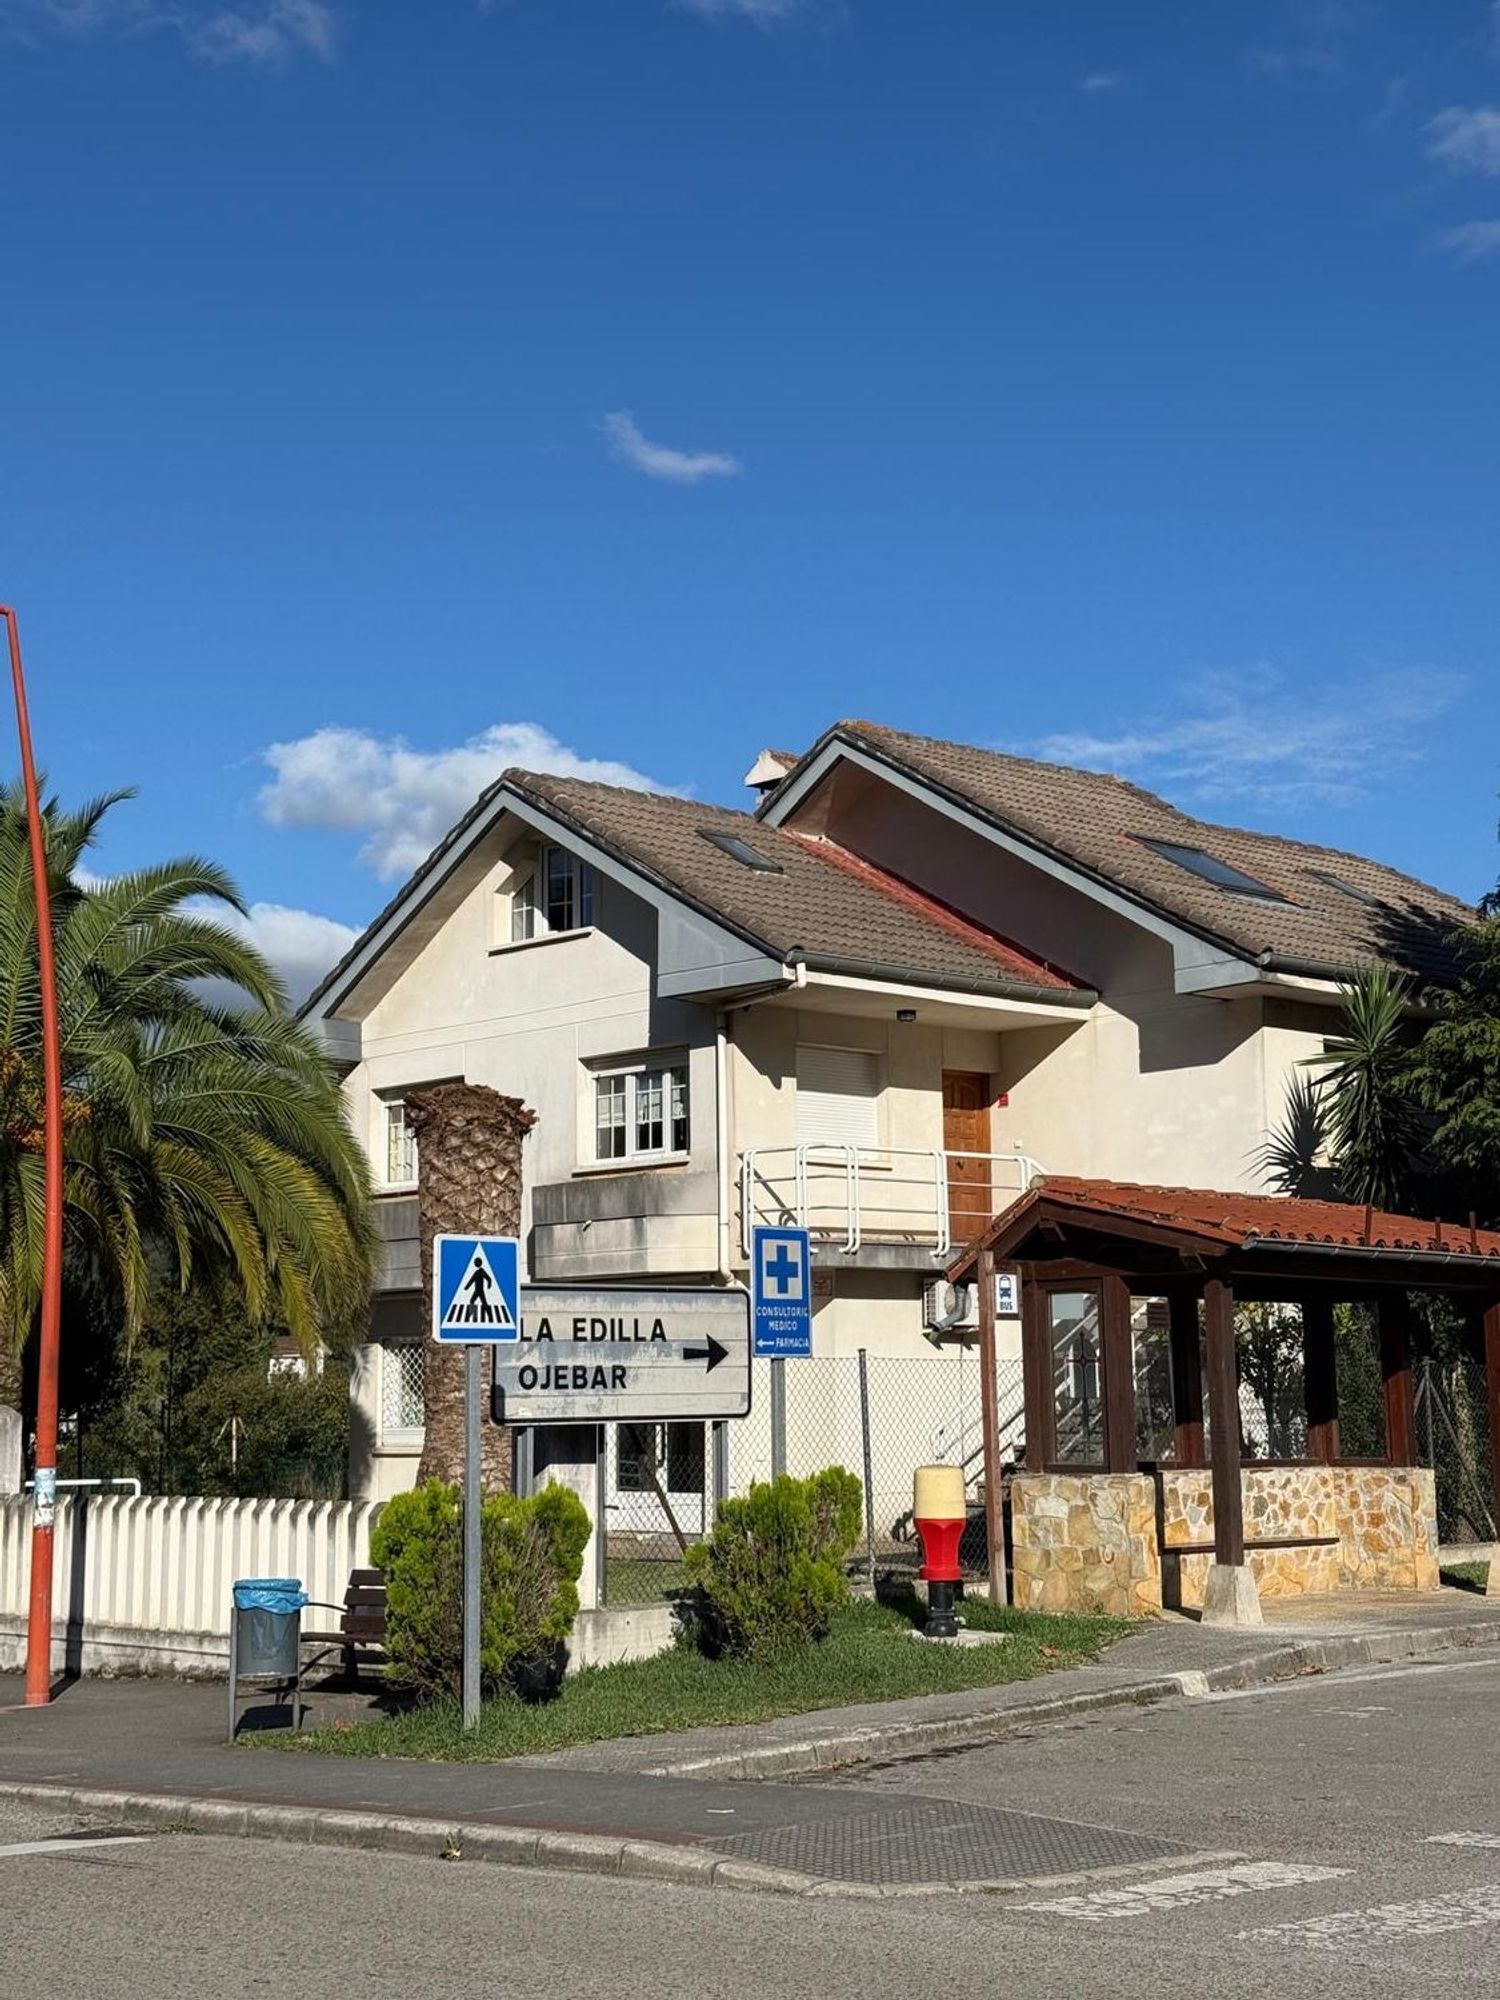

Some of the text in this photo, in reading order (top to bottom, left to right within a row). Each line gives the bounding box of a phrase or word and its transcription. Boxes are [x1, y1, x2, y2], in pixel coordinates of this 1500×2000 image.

[1000, 1301, 1013, 1311] BUS
[520, 1317, 667, 1342] LA EDILLA
[776, 1337, 809, 1348] FARMACIA
[518, 1364, 628, 1390] OJEBAR
